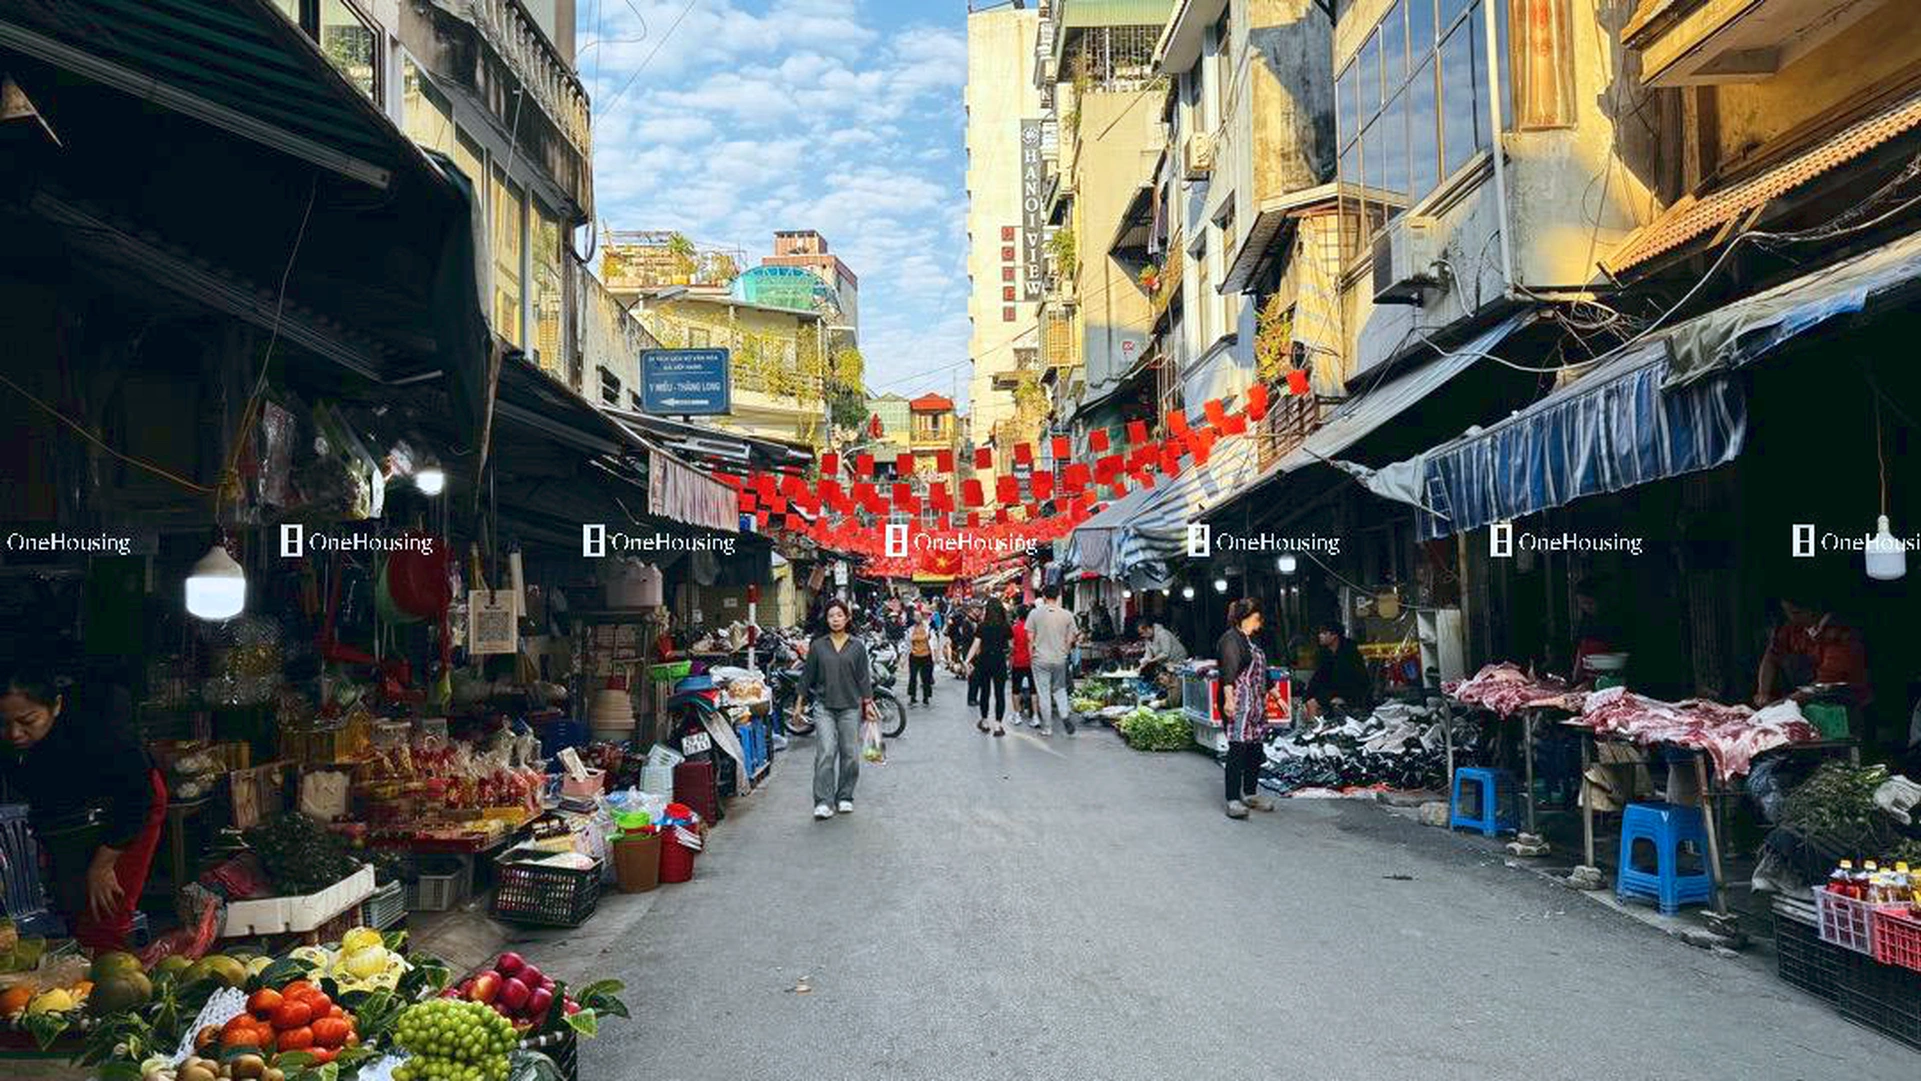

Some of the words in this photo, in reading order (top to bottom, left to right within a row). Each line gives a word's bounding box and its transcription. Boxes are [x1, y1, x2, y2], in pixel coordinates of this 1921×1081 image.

[1024, 152, 1038, 227] HANOI
[1026, 233, 1042, 295] VIEW
[702, 382, 721, 392] LONG
